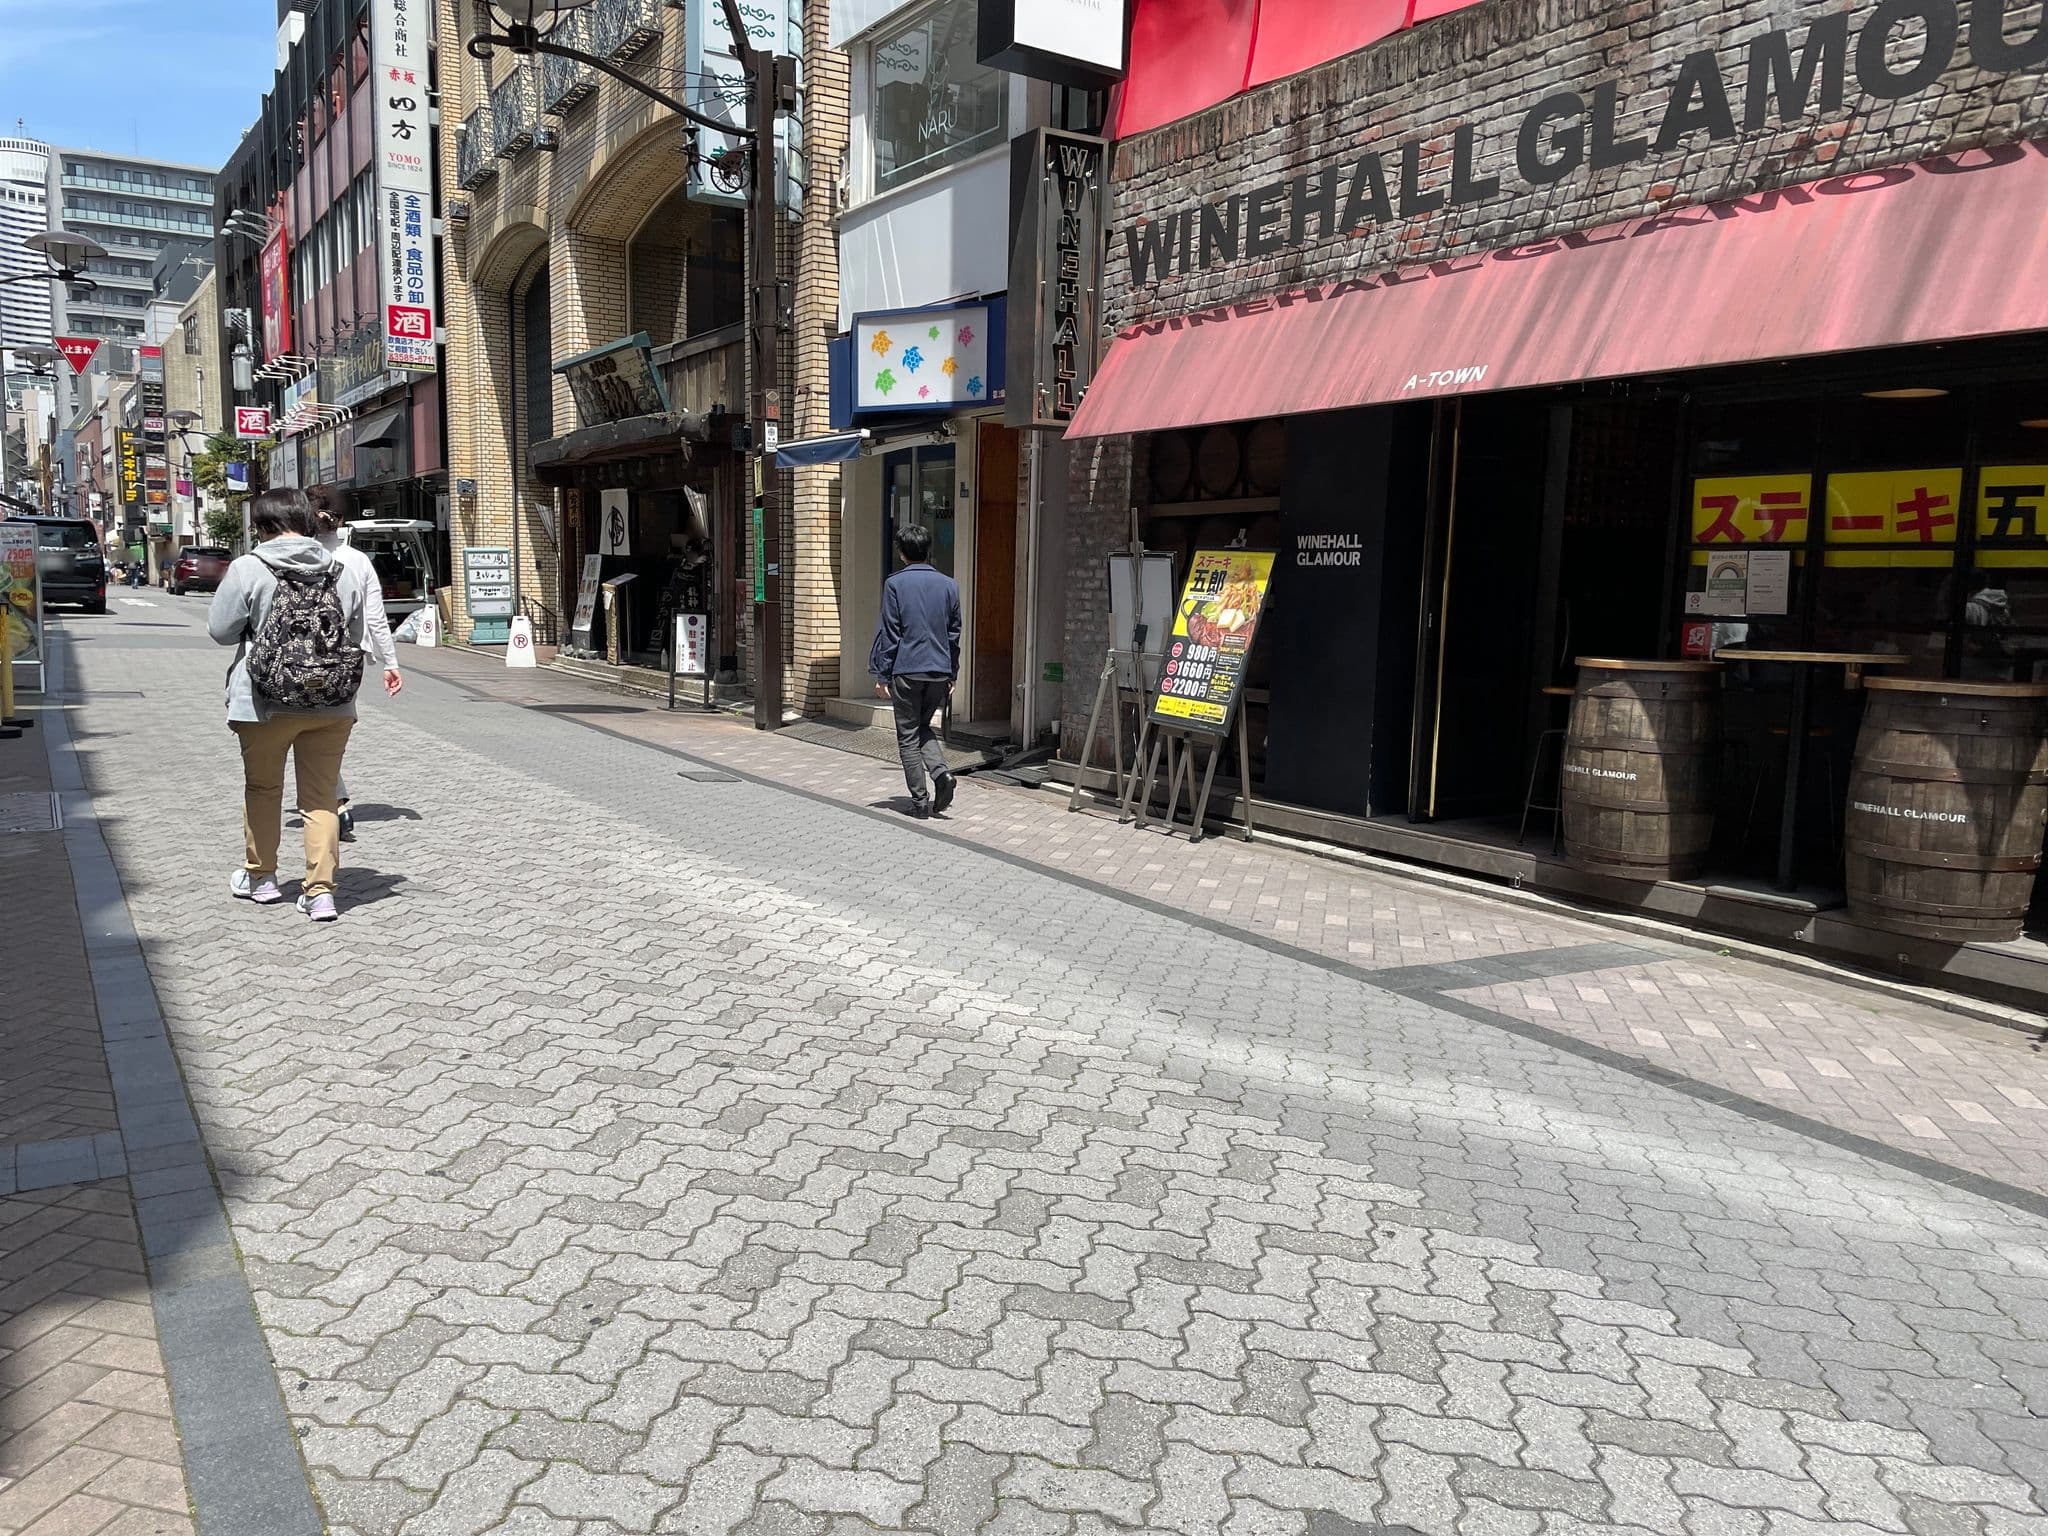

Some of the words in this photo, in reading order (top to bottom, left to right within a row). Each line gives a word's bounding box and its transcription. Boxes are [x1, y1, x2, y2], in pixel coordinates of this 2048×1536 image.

[393, 0, 408, 58] 総合商社
[389, 68, 416, 85] 赤坂
[389, 96, 417, 140] 四方
[918, 103, 958, 143] NARU
[389, 153, 421, 165] YOMO
[1126, 122, 1501, 287] WINEHALL
[404, 194, 424, 304] 全酒類・食品の卸
[1047, 144, 1089, 412] WINEHALL
[393, 311, 426, 335] 酒
[65, 344, 93, 355] 止まれ
[1403, 365, 1488, 391] A-TOWN
[240, 410, 267, 432] 酒
[1297, 534, 1362, 549] WINEHALL
[1198, 555, 1231, 569] ステーキ
[1296, 551, 1361, 567] GLAMOUR
[1190, 569, 1227, 594] 五郎
[688, 629, 697, 671] 駐車禁止
[1187, 643, 1217, 662] 980円
[1177, 660, 1212, 680] 1660円
[1171, 677, 1207, 698] 2200円
[1592, 768, 1637, 780] GLAMOUR
[1904, 809, 1966, 823] GLAMOUR
